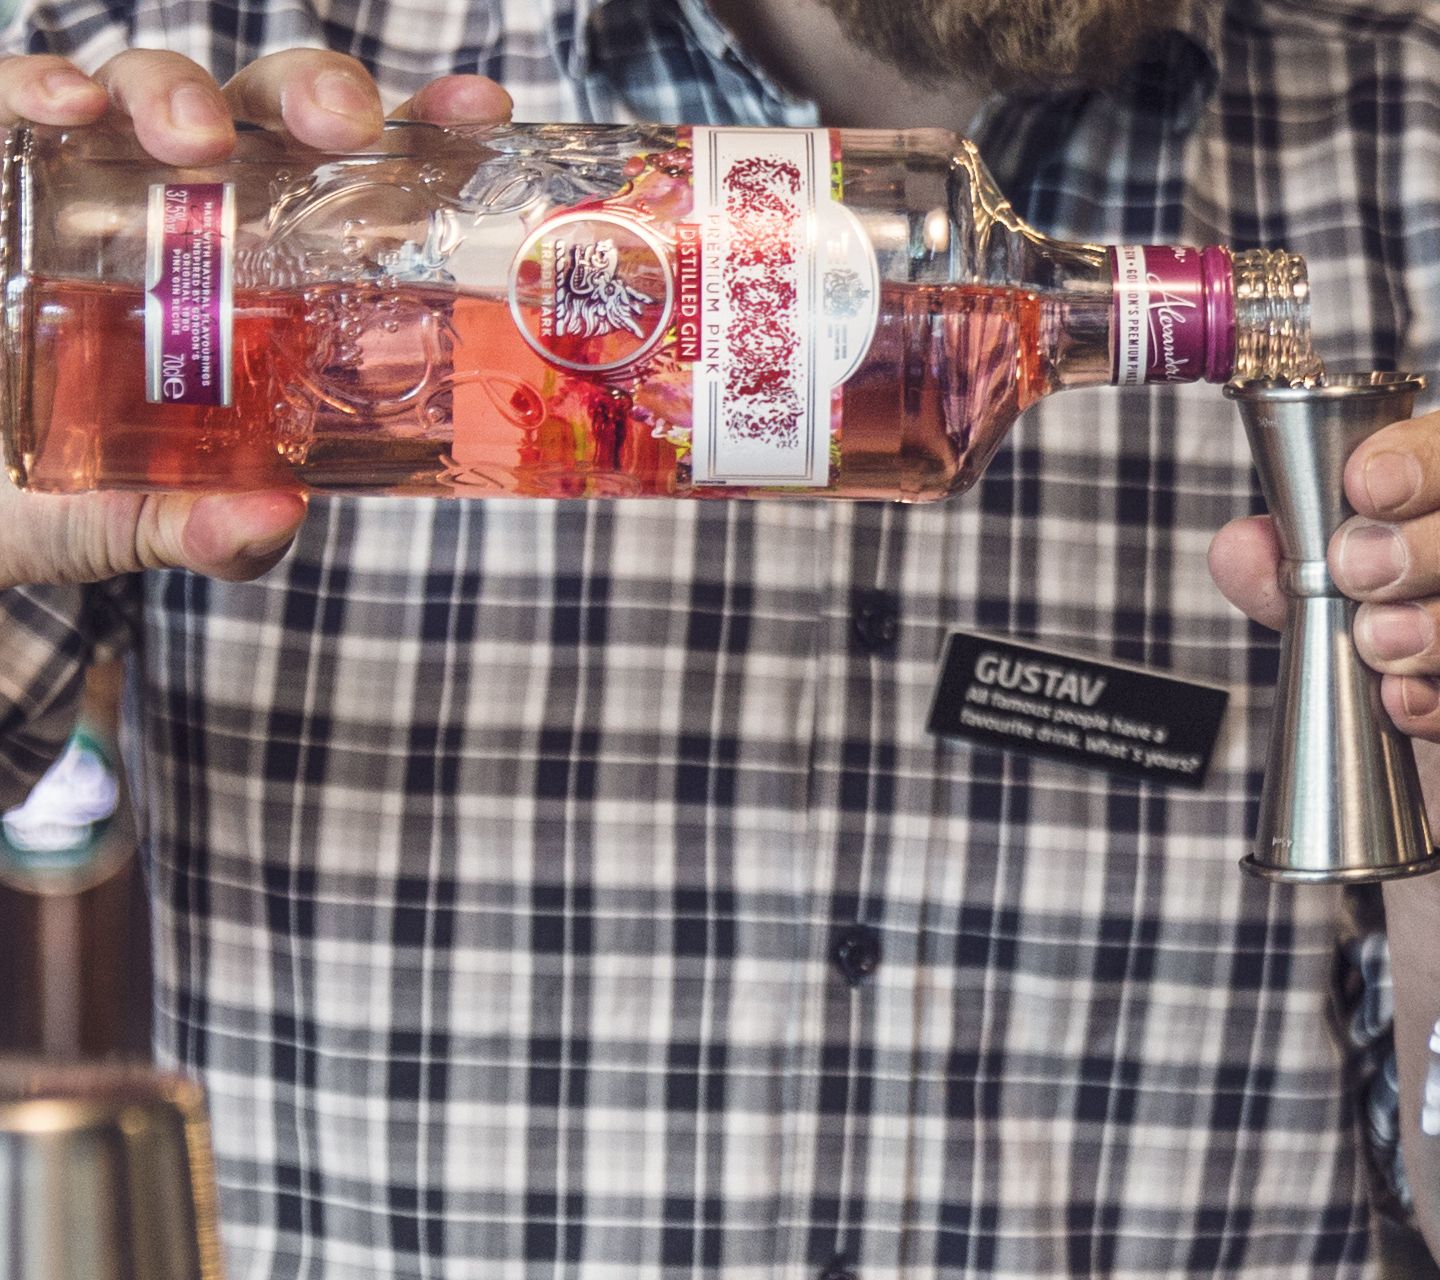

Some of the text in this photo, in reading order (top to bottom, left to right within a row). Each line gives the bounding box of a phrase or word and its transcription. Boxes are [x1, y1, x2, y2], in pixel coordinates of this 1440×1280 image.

[181, 253, 192, 302] ORIGINAL
[192, 238, 202, 287] INSPIRED
[541, 240, 552, 337] TRADE MARK
[171, 248, 181, 336] PINK GIN RECIPE
[191, 289, 201, 304] BY
[200, 202, 213, 386] MADE WITH NATURAL FLAVOURINGS
[681, 229, 697, 357] DISTILLED GIN
[706, 214, 720, 375] PREMIUM PINK
[1126, 269, 1140, 316] GOON'S
[191, 307, 201, 361] GORDON'S
[1128, 319, 1140, 362] PREMIUM
[973, 653, 1108, 706] GUSTAV
[990, 692, 1052, 718] famous
[1052, 709, 1109, 732] people
[1112, 718, 1152, 741] have
